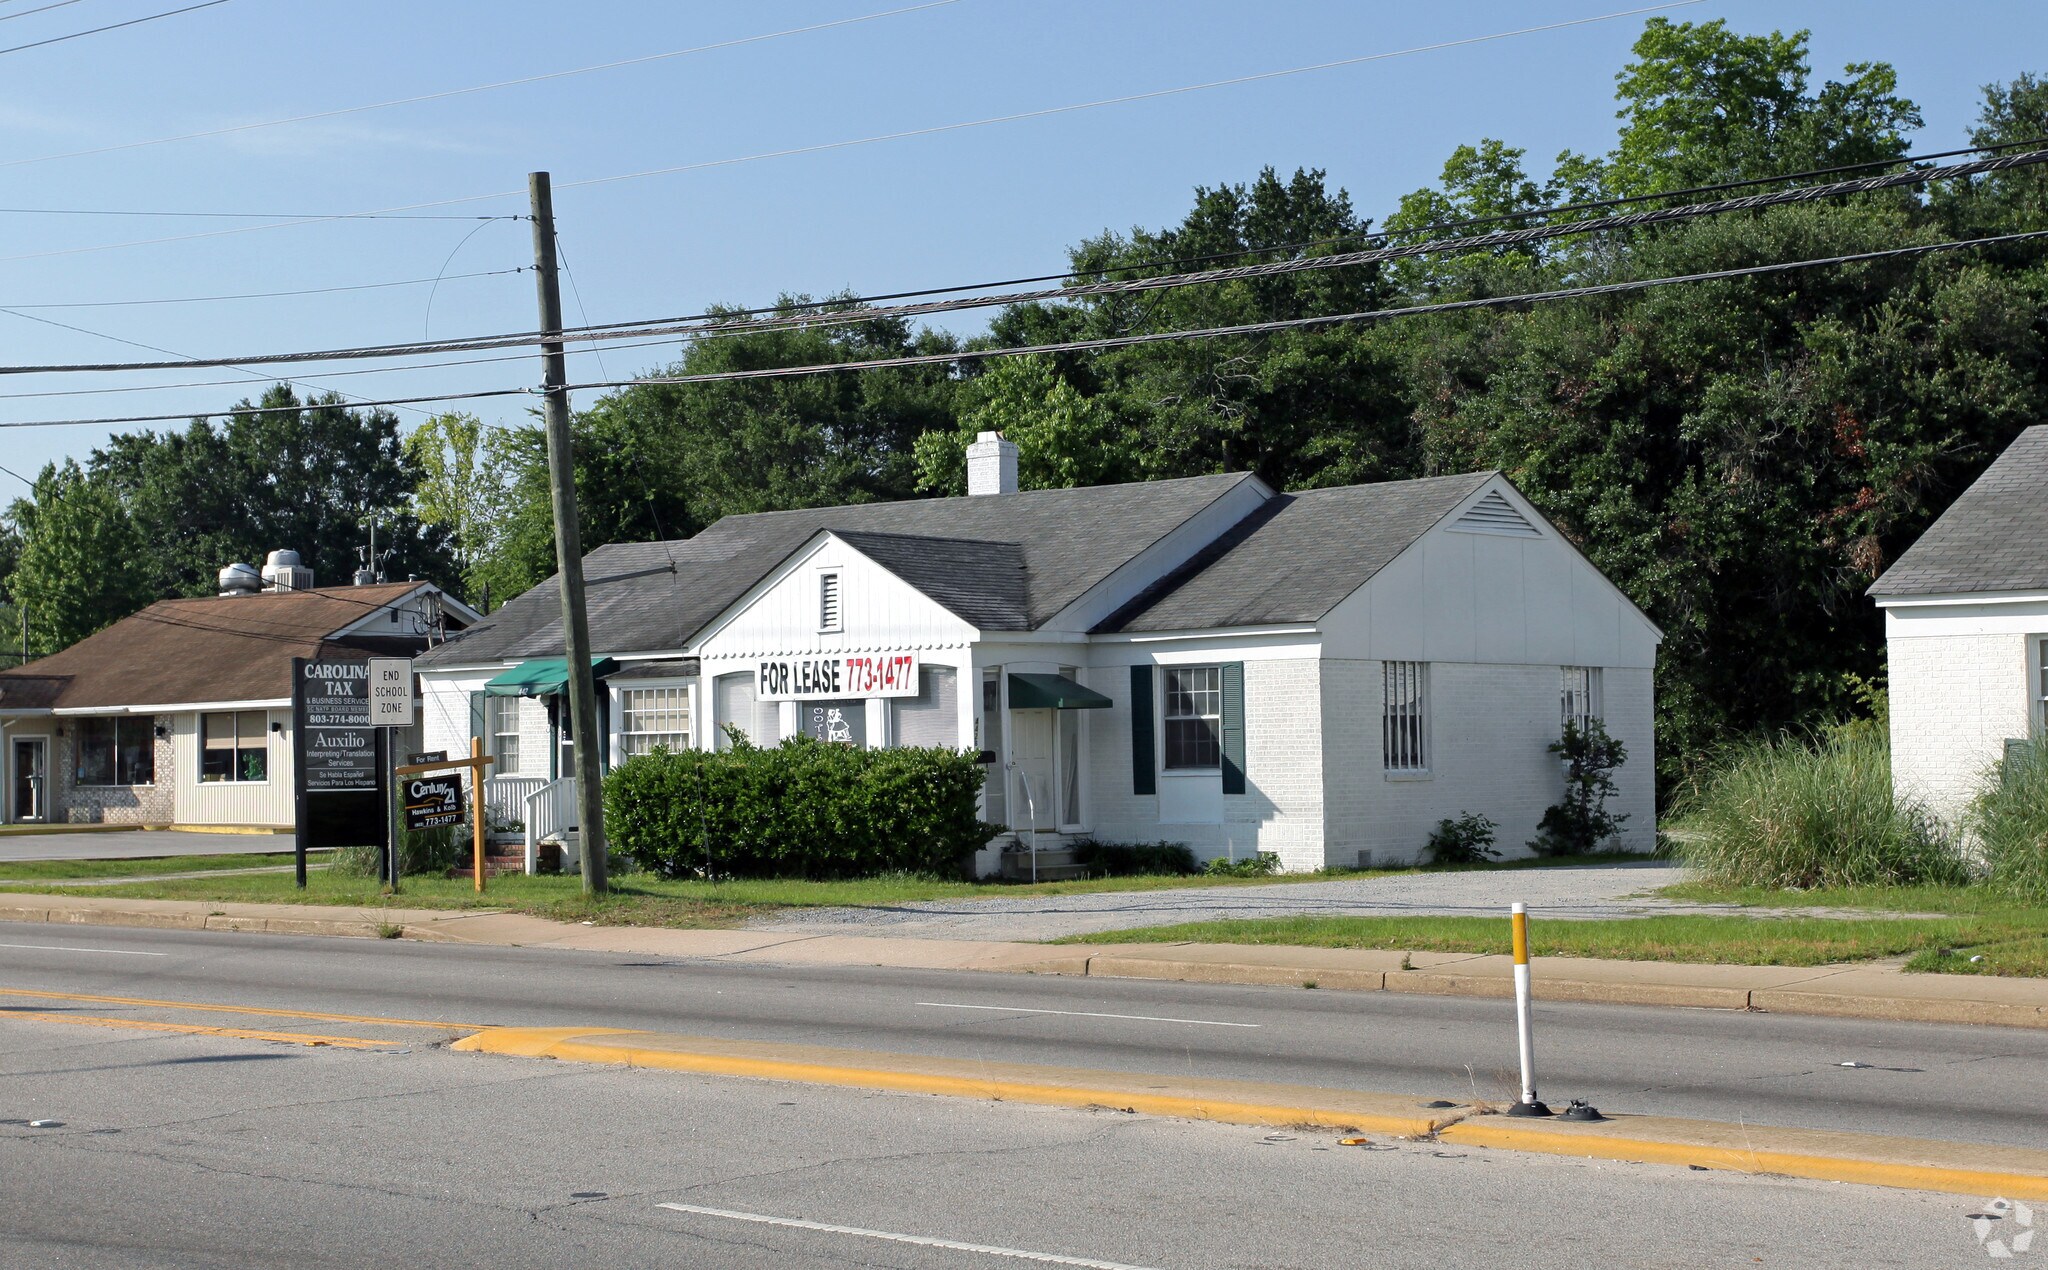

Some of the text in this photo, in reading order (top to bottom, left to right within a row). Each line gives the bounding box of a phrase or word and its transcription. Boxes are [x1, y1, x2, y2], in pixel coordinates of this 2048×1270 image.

[383, 670, 399, 681] END
[760, 656, 912, 695] FOR LEASE 773-1477
[325, 681, 353, 695] TAX
[375, 686, 408, 697] SCHOOL
[381, 703, 402, 713] ZONE
[309, 714, 369, 724] 803-774-8000
[314, 732, 365, 747] Auxilio
[306, 750, 375, 758] Interpreting/Translation
[411, 781, 456, 804] Century 21
[412, 808, 434, 816] Hawkins
[425, 815, 457, 826] 773-1477
